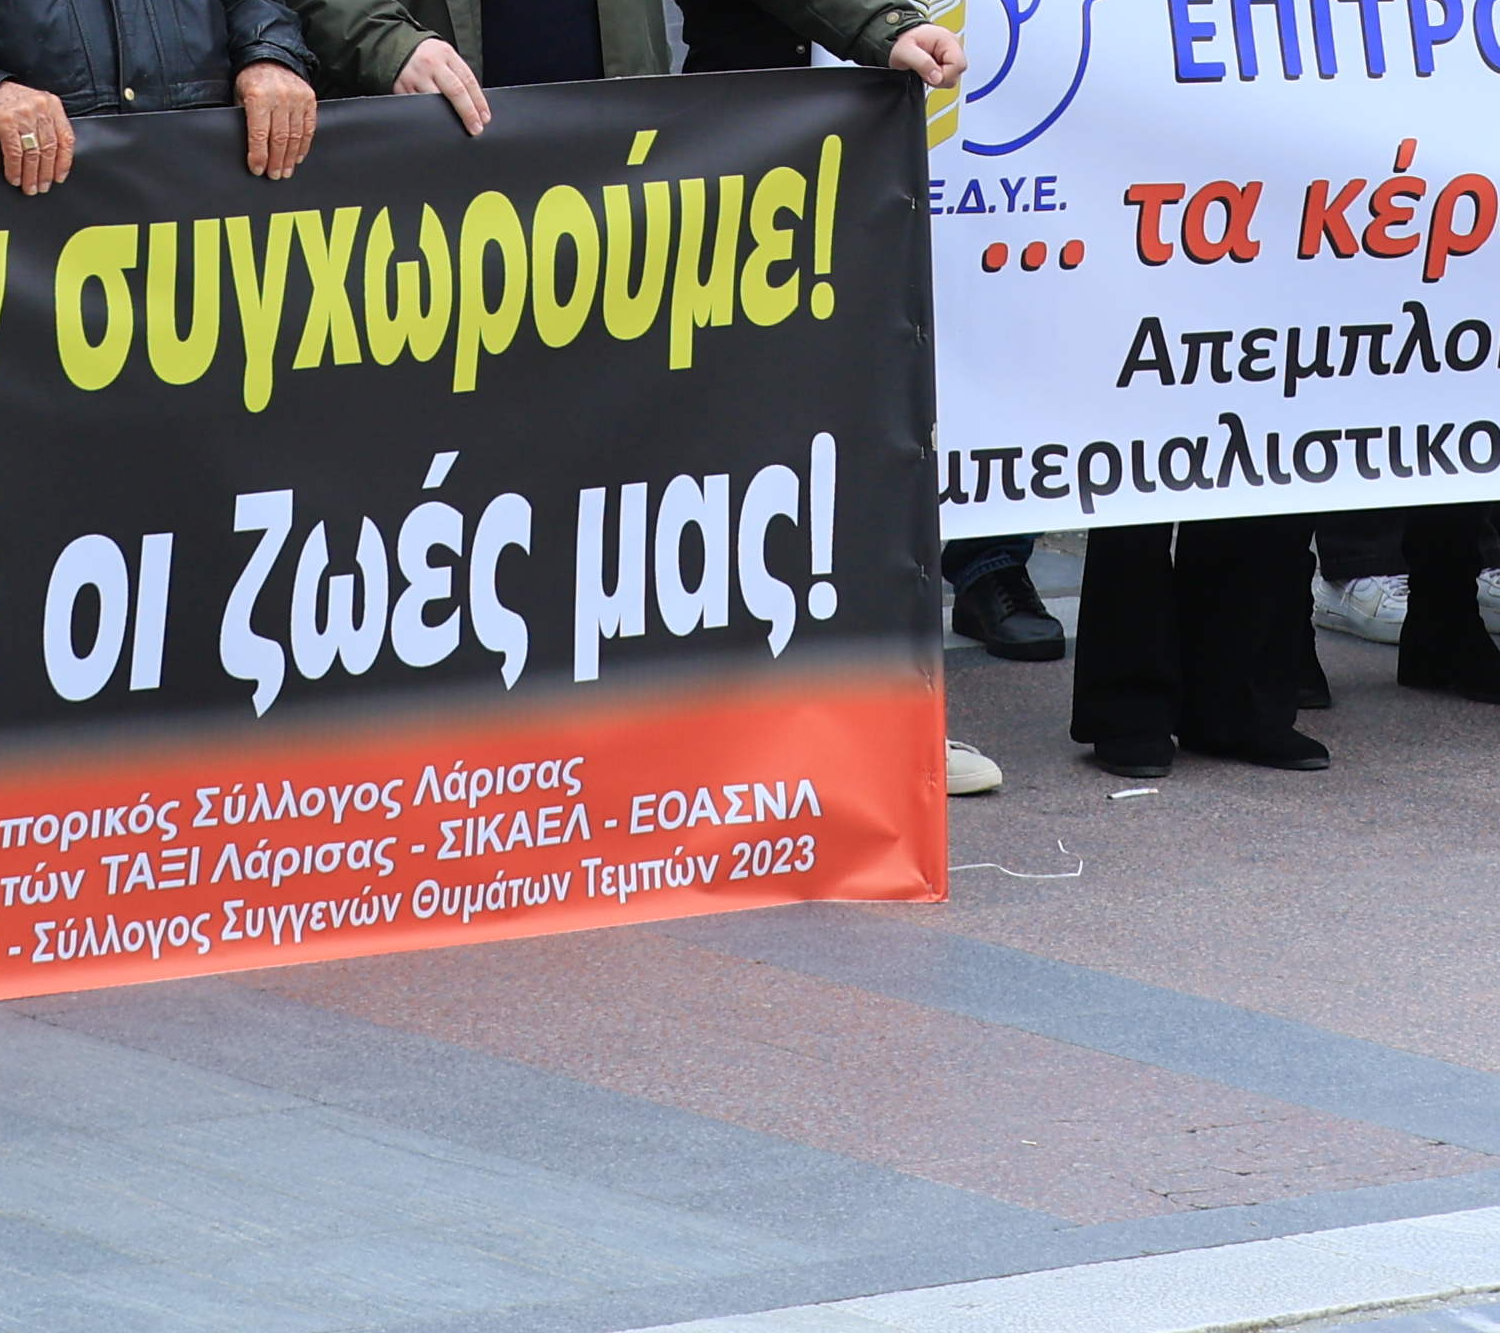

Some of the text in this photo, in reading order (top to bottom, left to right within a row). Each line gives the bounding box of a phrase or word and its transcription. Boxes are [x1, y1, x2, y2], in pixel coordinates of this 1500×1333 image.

[55, 129, 843, 414] συγχωρούμε!
[1123, 179, 1261, 267] τα
[42, 531, 174, 703] οι
[220, 451, 531, 719] ζωές
[573, 431, 838, 683] μας!
[99, 849, 200, 896] ΤΑΞΙ
[210, 827, 399, 888] Λάρισας
[436, 807, 592, 861] ΣΙΚΑΕΛ
[629, 779, 820, 830] ΕΟΑΣΝΛ
[191, 774, 403, 833] Σύλλογος
[413, 752, 584, 808] Λάρισας
[32, 909, 211, 967] Σύλλογος
[221, 889, 401, 947] Συγγενών
[411, 871, 571, 927] Θυμάτων
[581, 851, 718, 904] Τεμπών
[729, 835, 815, 879] 2023
